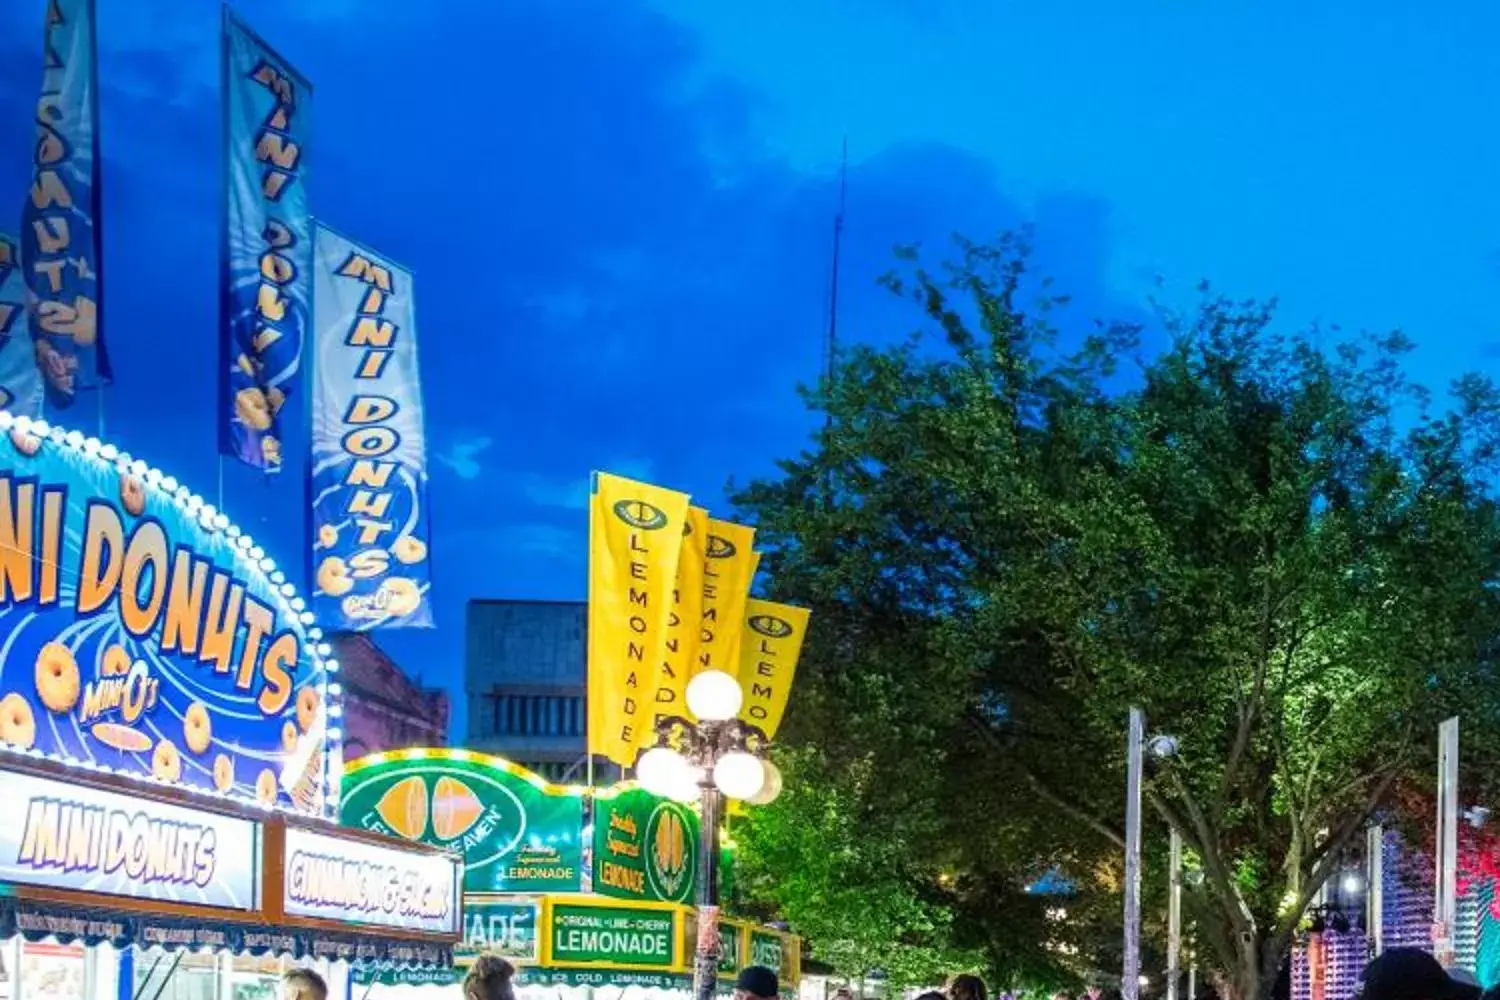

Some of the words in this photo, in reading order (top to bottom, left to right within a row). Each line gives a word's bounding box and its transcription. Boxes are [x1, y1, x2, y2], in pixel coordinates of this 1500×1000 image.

[333, 250, 398, 379] MINI
[341, 394, 400, 579] DONUTS
[76, 500, 301, 716] DONUTS
[620, 533, 649, 743] LEMONADE
[17, 797, 106, 875] MINI
[104, 810, 218, 888] DONUTS
[501, 865, 574, 880] LEMONADE
[600, 860, 646, 895] LEMONADE
[556, 929, 668, 956] LEMONADE
[635, 919, 671, 932] CHERRY
[610, 974, 662, 985] LEMONADE
